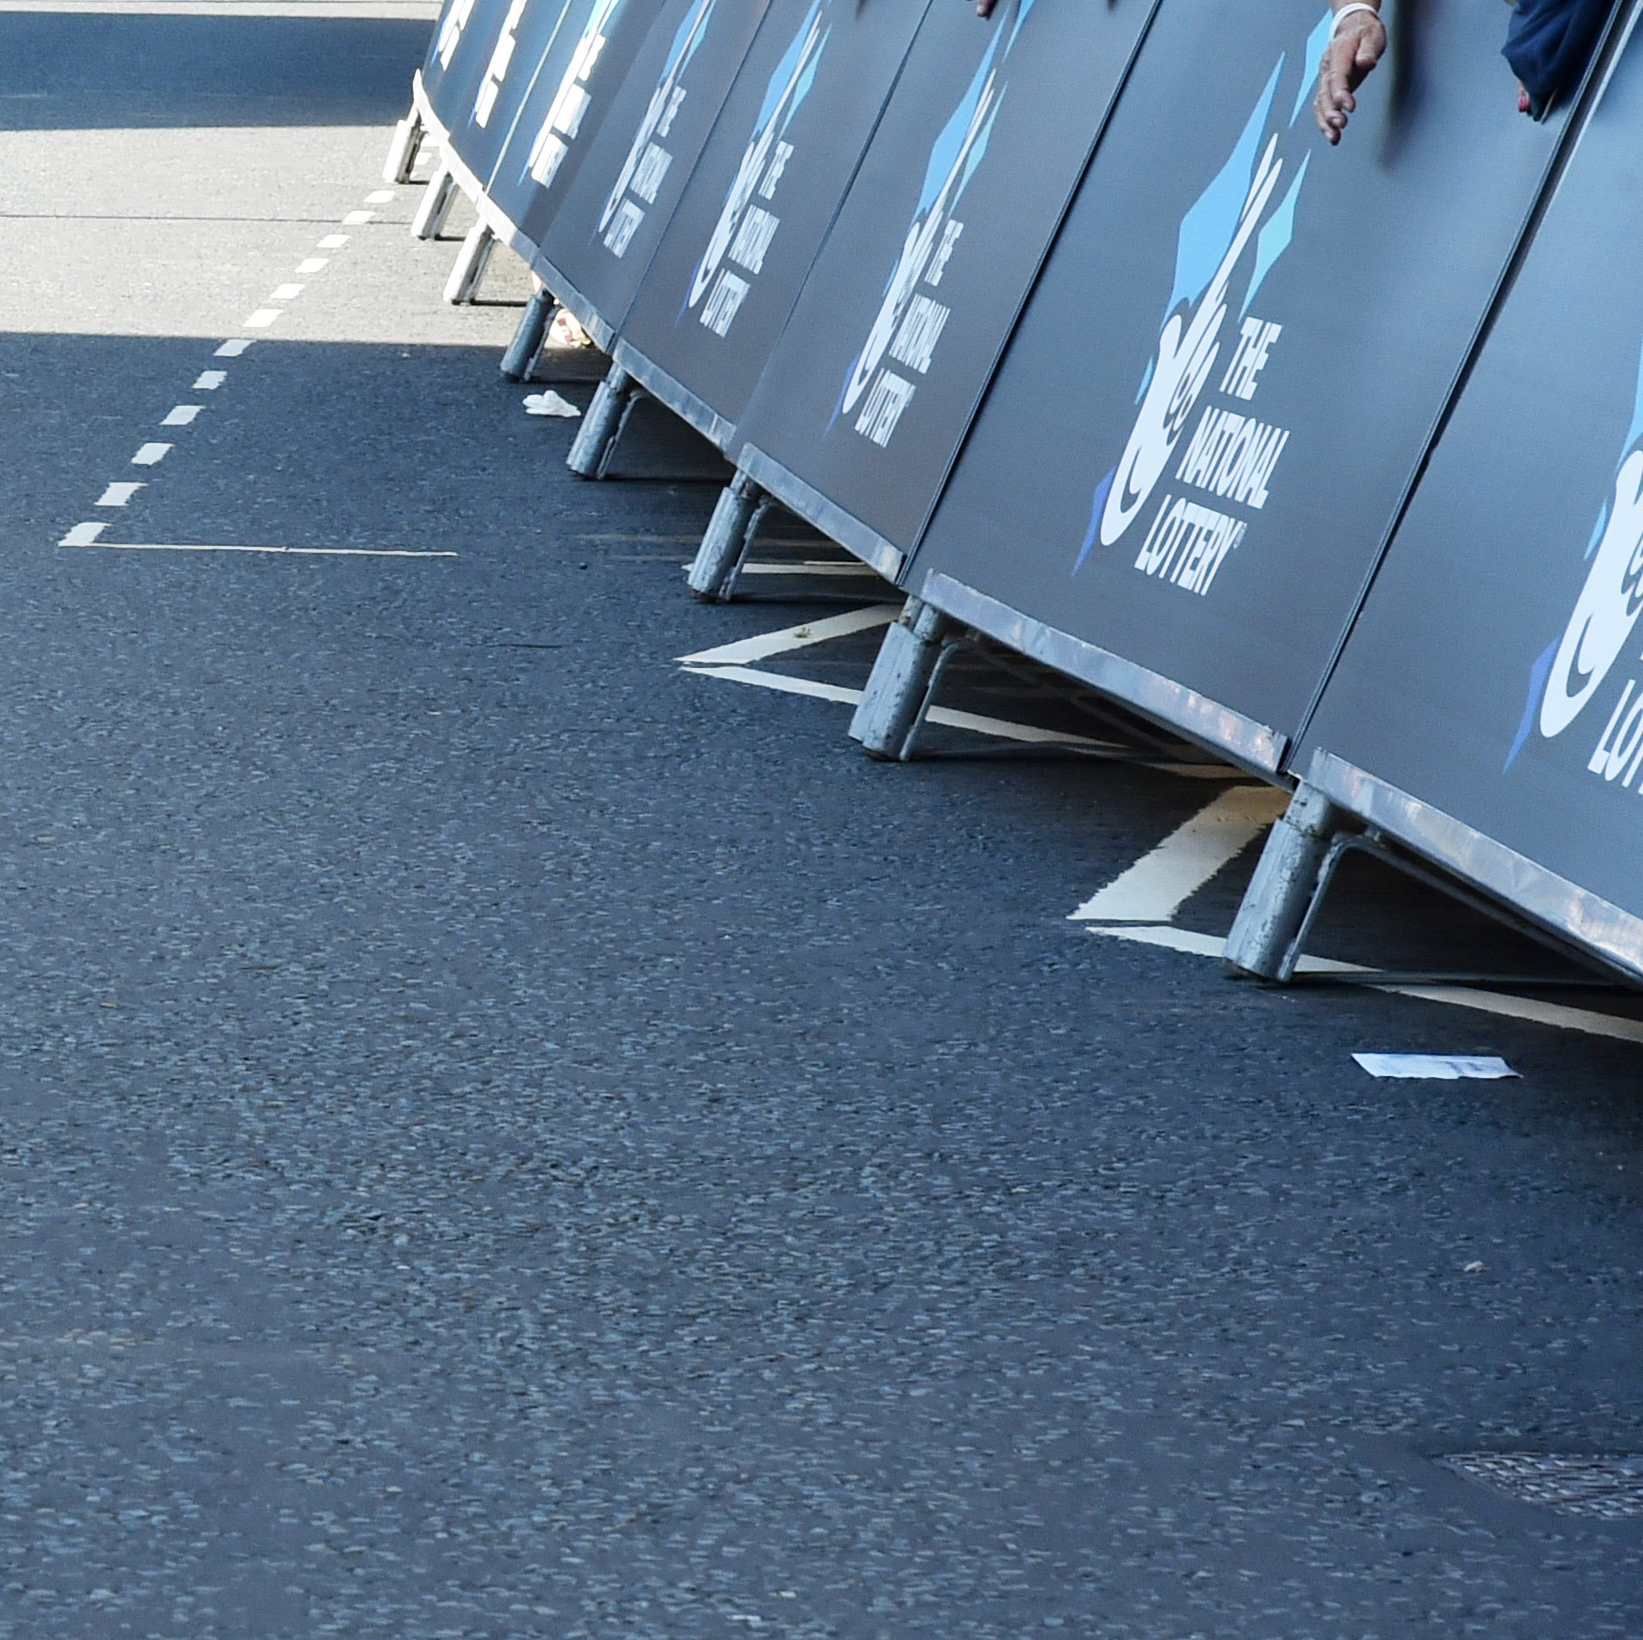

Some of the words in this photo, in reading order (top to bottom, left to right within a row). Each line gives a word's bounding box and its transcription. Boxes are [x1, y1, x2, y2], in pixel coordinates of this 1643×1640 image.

[924, 218, 964, 288] THE
[1219, 316, 1283, 401] THE
[854, 366, 917, 449] LOTTERY
[1175, 404, 1290, 510] NATIONAL
[1133, 493, 1245, 597] LOTTERY
